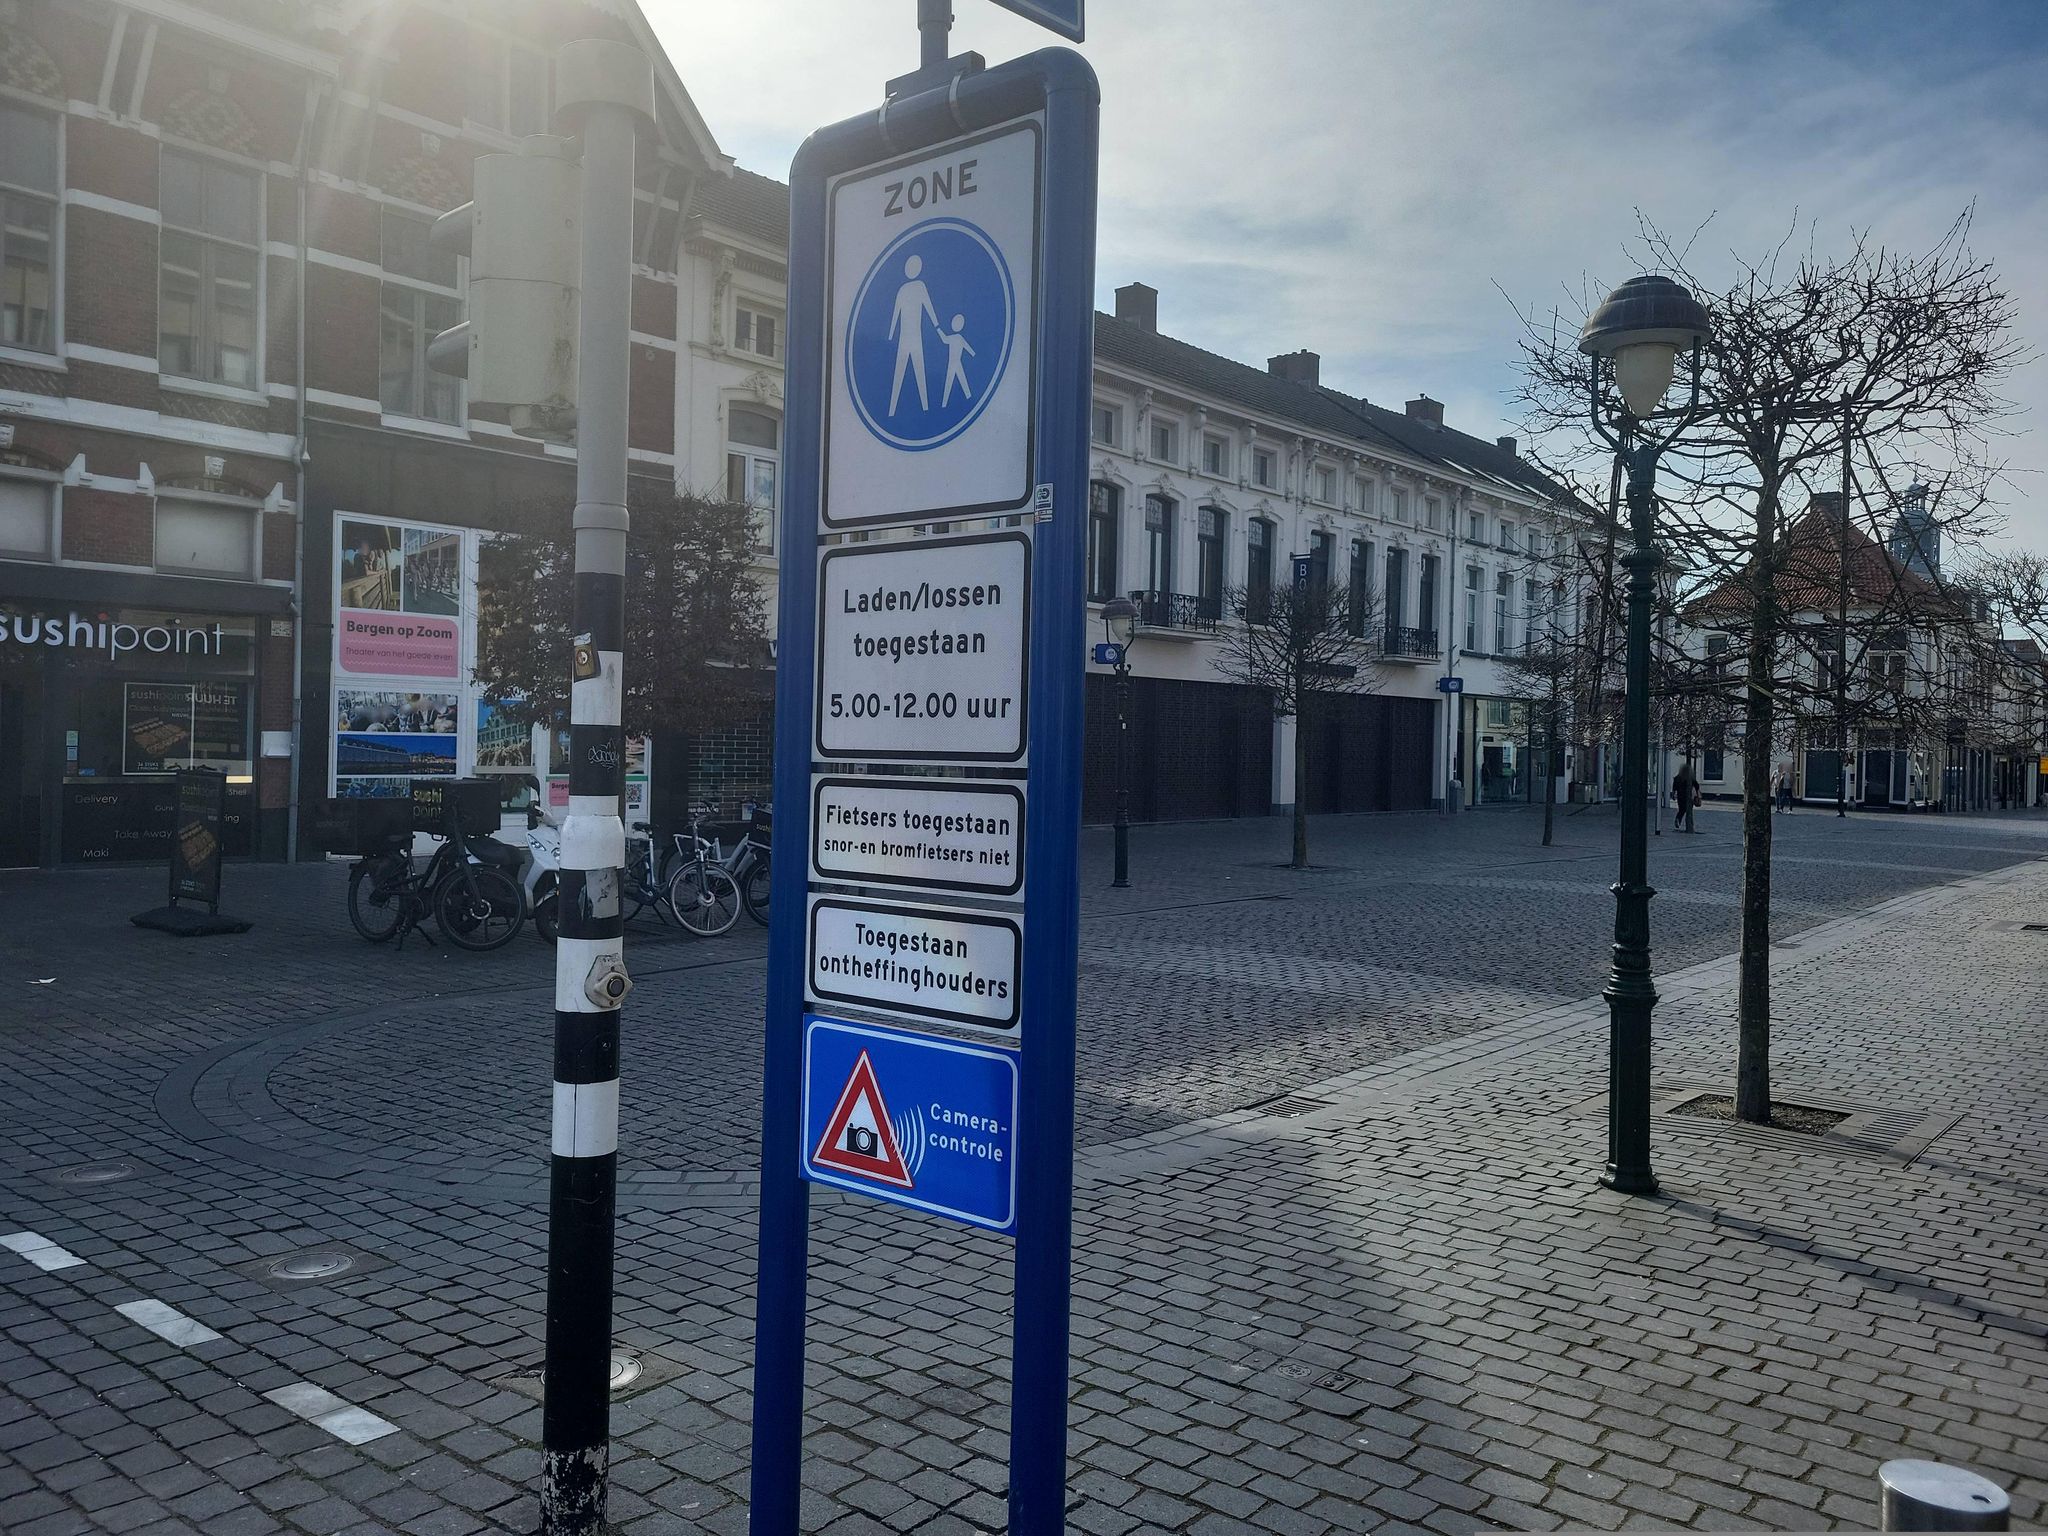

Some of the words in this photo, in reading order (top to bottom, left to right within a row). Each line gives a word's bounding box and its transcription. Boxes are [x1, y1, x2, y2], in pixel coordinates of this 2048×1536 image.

[883, 159, 978, 217] ZONE
[844, 582, 1001, 613] Laden/lossen
[346, 620, 394, 636] Bergen
[397, 626, 414, 639] op
[417, 626, 452, 639] Zoom
[346, 647, 375, 656] Theater
[407, 651, 432, 661] goede
[854, 629, 985, 663] toegestaan
[830, 692, 957, 718] 5.00-12.00
[967, 696, 1011, 718] uur
[75, 795, 118, 805] Delivery
[413, 787, 442, 804] sushi
[115, 830, 139, 839] Take
[143, 830, 173, 839] Away
[826, 804, 897, 828] Fietsers
[903, 809, 1010, 837] toegestaan
[83, 848, 109, 858] Maki
[824, 838, 876, 855] snor-en
[881, 841, 973, 863] bromfietsers
[979, 849, 1010, 866] niet
[855, 923, 968, 959] Toegestaan
[820, 954, 1008, 999] ontheffinghouders
[930, 1103, 1008, 1134] Camera-
[929, 1131, 1003, 1163] controle
